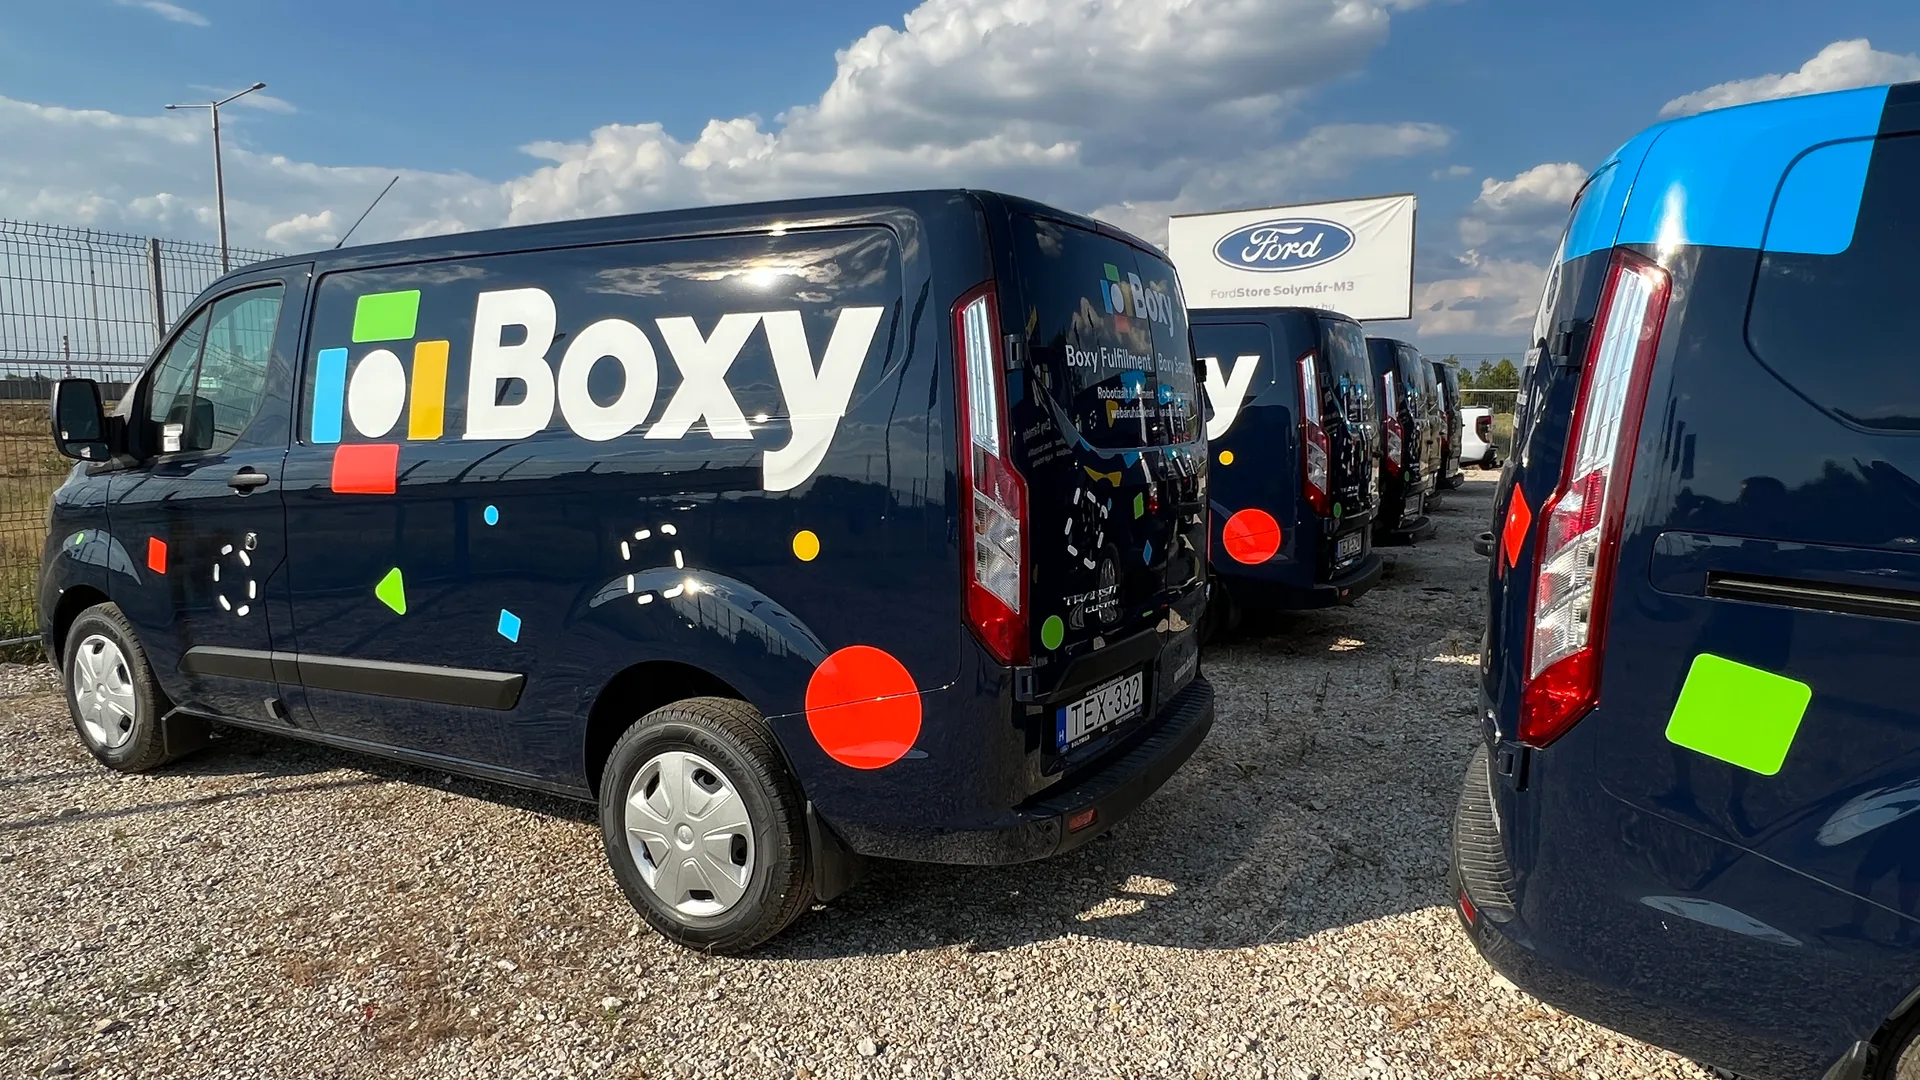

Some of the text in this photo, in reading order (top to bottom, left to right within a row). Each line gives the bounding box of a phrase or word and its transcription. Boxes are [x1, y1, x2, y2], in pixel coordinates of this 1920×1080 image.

[1241, 226, 1324, 263] Ford
[1127, 271, 1174, 338] Boxy
[1210, 281, 1355, 299] FordStore Solymár-M3
[1065, 344, 1098, 373] Boxy
[1100, 346, 1152, 371] Fulfillment
[1157, 352, 1174, 378] Boxy
[462, 287, 885, 493] Boxy
[1065, 583, 1121, 606] TRANSIT
[1071, 676, 1140, 736] TEX-332
[1058, 729, 1065, 742] H
